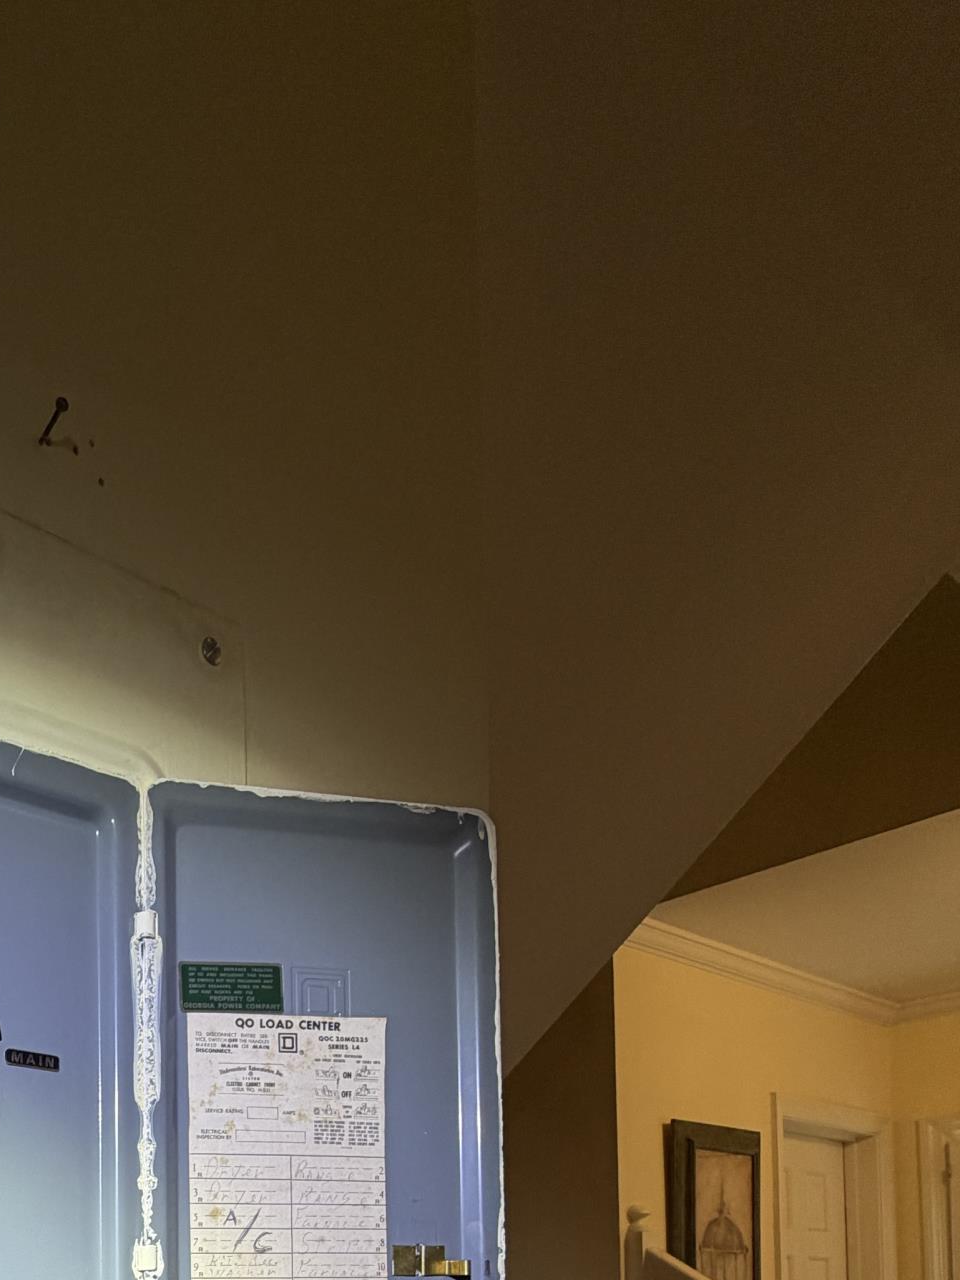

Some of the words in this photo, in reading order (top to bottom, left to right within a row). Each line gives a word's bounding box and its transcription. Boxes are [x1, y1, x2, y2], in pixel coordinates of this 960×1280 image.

[235, 1017, 255, 1030] QO
[259, 1018, 294, 1030] LOAD
[299, 1020, 341, 1032] CENTER
[10, 1051, 55, 1068] MAIN
[342, 1071, 352, 1080] ON
[341, 1090, 352, 1099] OFF
[378, 1166, 384, 1175] 2
[193, 1188, 199, 1198] 3
[379, 1190, 385, 1199] 4
[193, 1213, 199, 1222] 5
[379, 1214, 385, 1223] 6
[223, 1206, 273, 1254] A/C
[193, 1237, 199, 1247] 7
[193, 1262, 199, 1272] 9
[377, 1262, 386, 1271] 10
